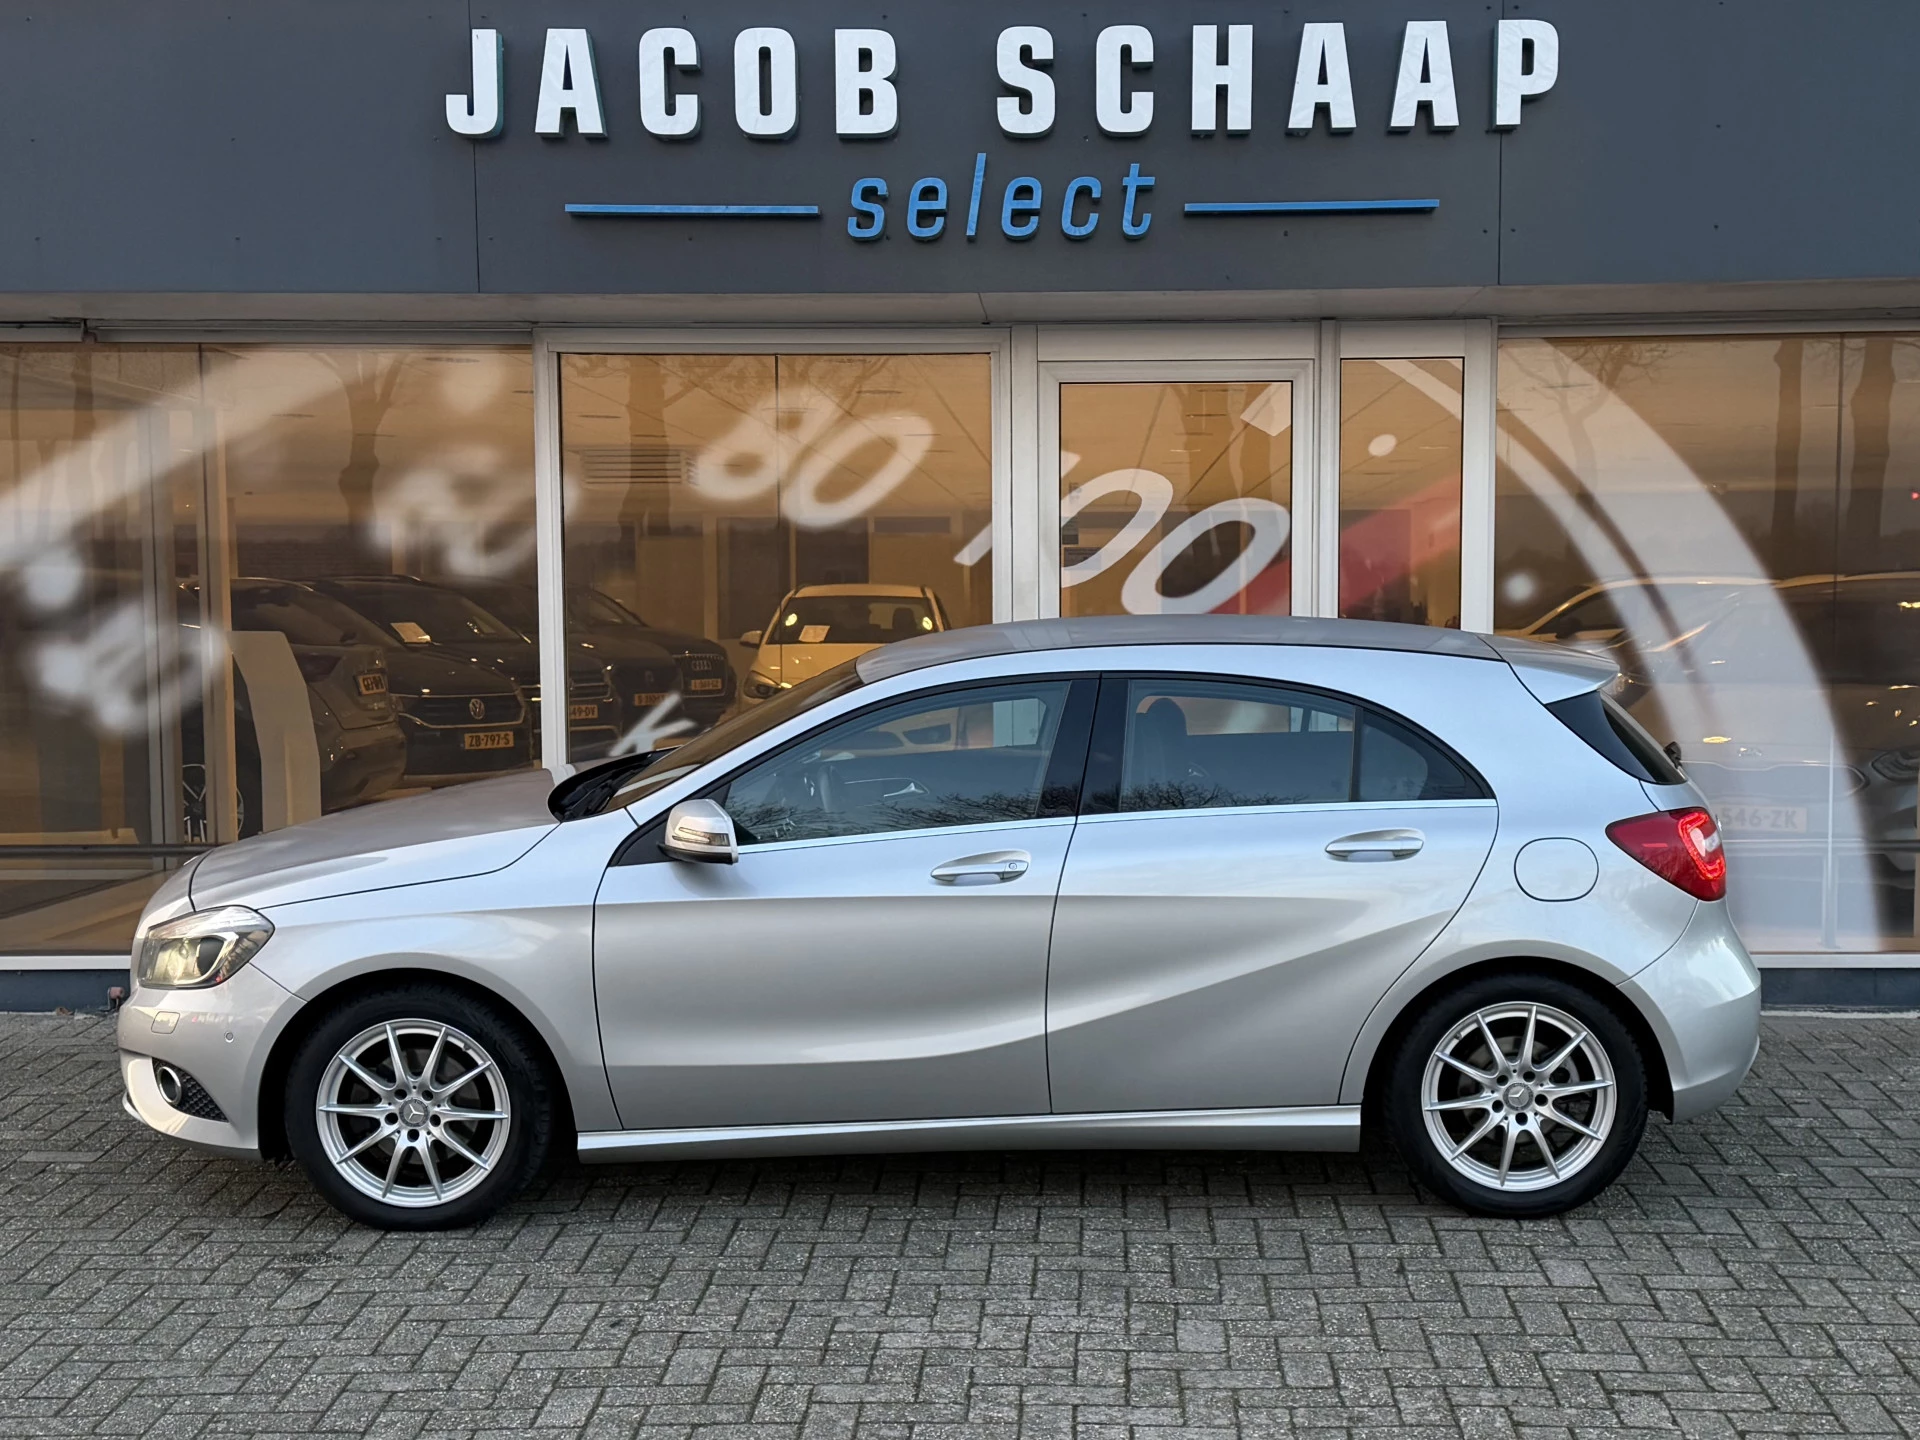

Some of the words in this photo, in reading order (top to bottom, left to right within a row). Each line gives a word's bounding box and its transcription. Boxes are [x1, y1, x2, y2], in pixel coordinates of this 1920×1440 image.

[445, 27, 899, 138] JACOB
[996, 19, 1559, 137] SCHAAP
[847, 152, 1156, 241] select
[469, 733, 511, 748] ZB-797-S
